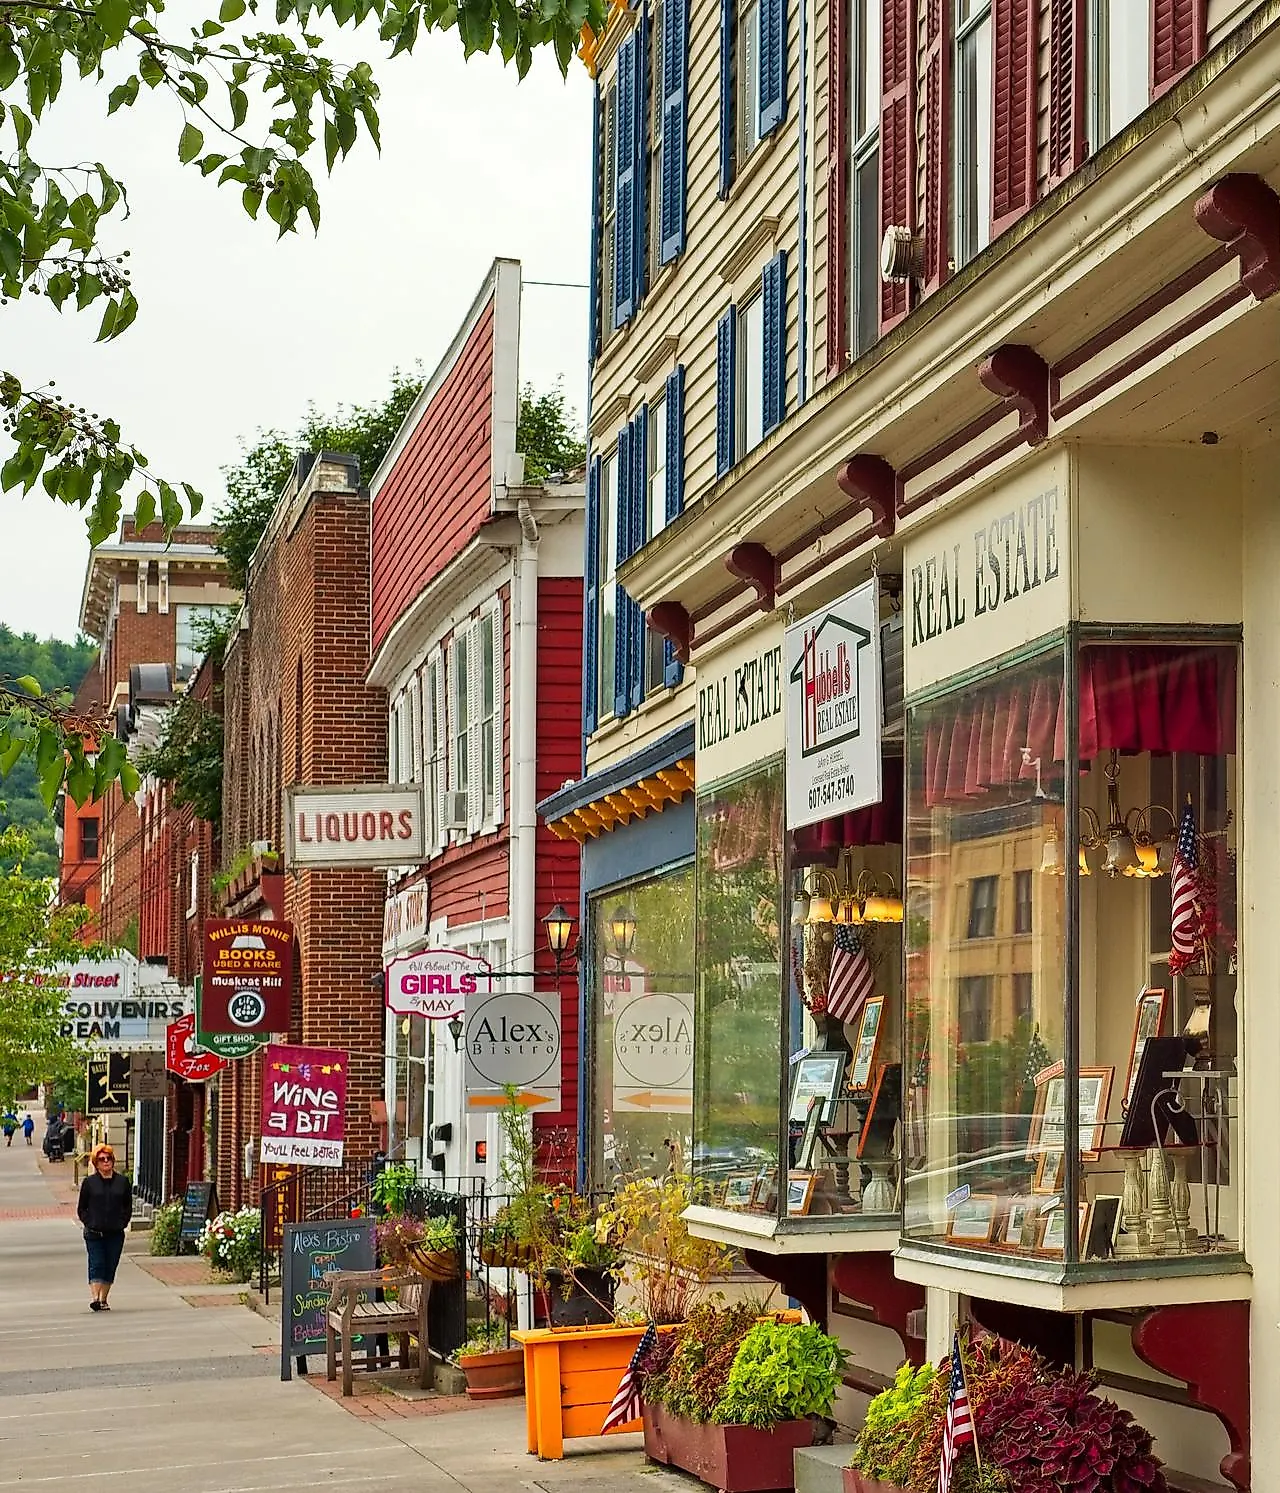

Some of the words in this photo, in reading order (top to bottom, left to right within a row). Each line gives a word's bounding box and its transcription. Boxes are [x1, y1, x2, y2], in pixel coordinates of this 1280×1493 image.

[911, 543, 966, 647] REAL
[974, 486, 1060, 617] ESTATE
[804, 627, 851, 749] Hubbell's
[699, 675, 730, 751] REAL
[734, 645, 782, 734] ESTATE
[817, 704, 834, 735] REAL
[835, 696, 857, 729] ESTATE
[808, 774, 855, 810] 607-547-5740
[299, 809, 412, 842] LIQUORS
[209, 924, 249, 942] WILLIS
[252, 925, 290, 943] MONIE
[213, 960, 242, 968] USED
[243, 960, 250, 968] &
[253, 960, 281, 968] RARE
[219, 950, 276, 960] BOOKS
[409, 960, 423, 971] All
[424, 960, 450, 971] About
[451, 960, 470, 971] The
[73, 972, 120, 988] Street
[212, 977, 259, 987] Muskrat
[262, 977, 282, 987] Hill
[401, 974, 477, 994] GIRLS
[65, 1002, 184, 1018] SOUVENIRS
[422, 1000, 454, 1011] MAY
[59, 1021, 121, 1039] REAM
[472, 1015, 554, 1043] Alex's
[213, 1035, 231, 1043] GIFT
[232, 1034, 255, 1043] SHOP
[472, 1045, 554, 1055] Bistro
[180, 1059, 210, 1075] Fox
[268, 1112, 287, 1131] a
[326, 1230, 360, 1248] Bistro
